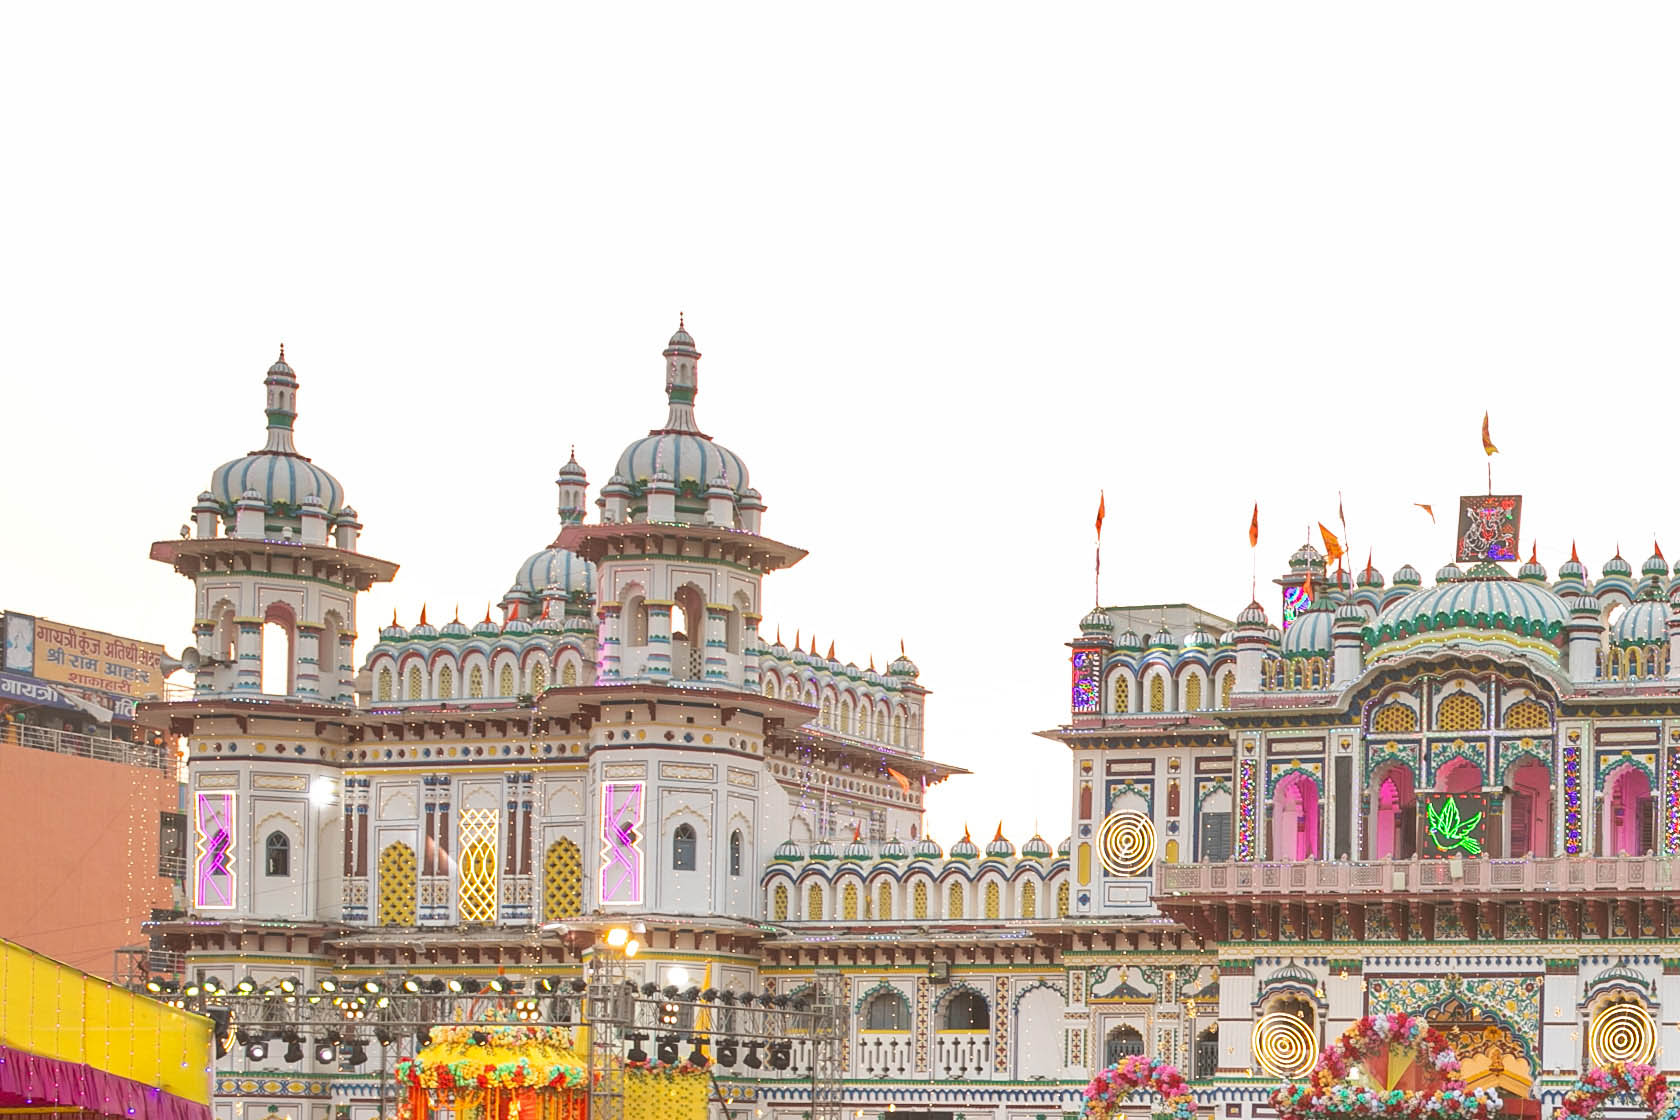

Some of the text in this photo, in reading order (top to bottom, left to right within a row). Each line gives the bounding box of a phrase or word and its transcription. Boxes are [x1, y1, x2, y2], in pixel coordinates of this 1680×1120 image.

[37, 626, 77, 649] गायत्री
[47, 647, 64, 665] श्री
[66, 654, 98, 672] राम
[68, 672, 132, 694] शाकाहारी
